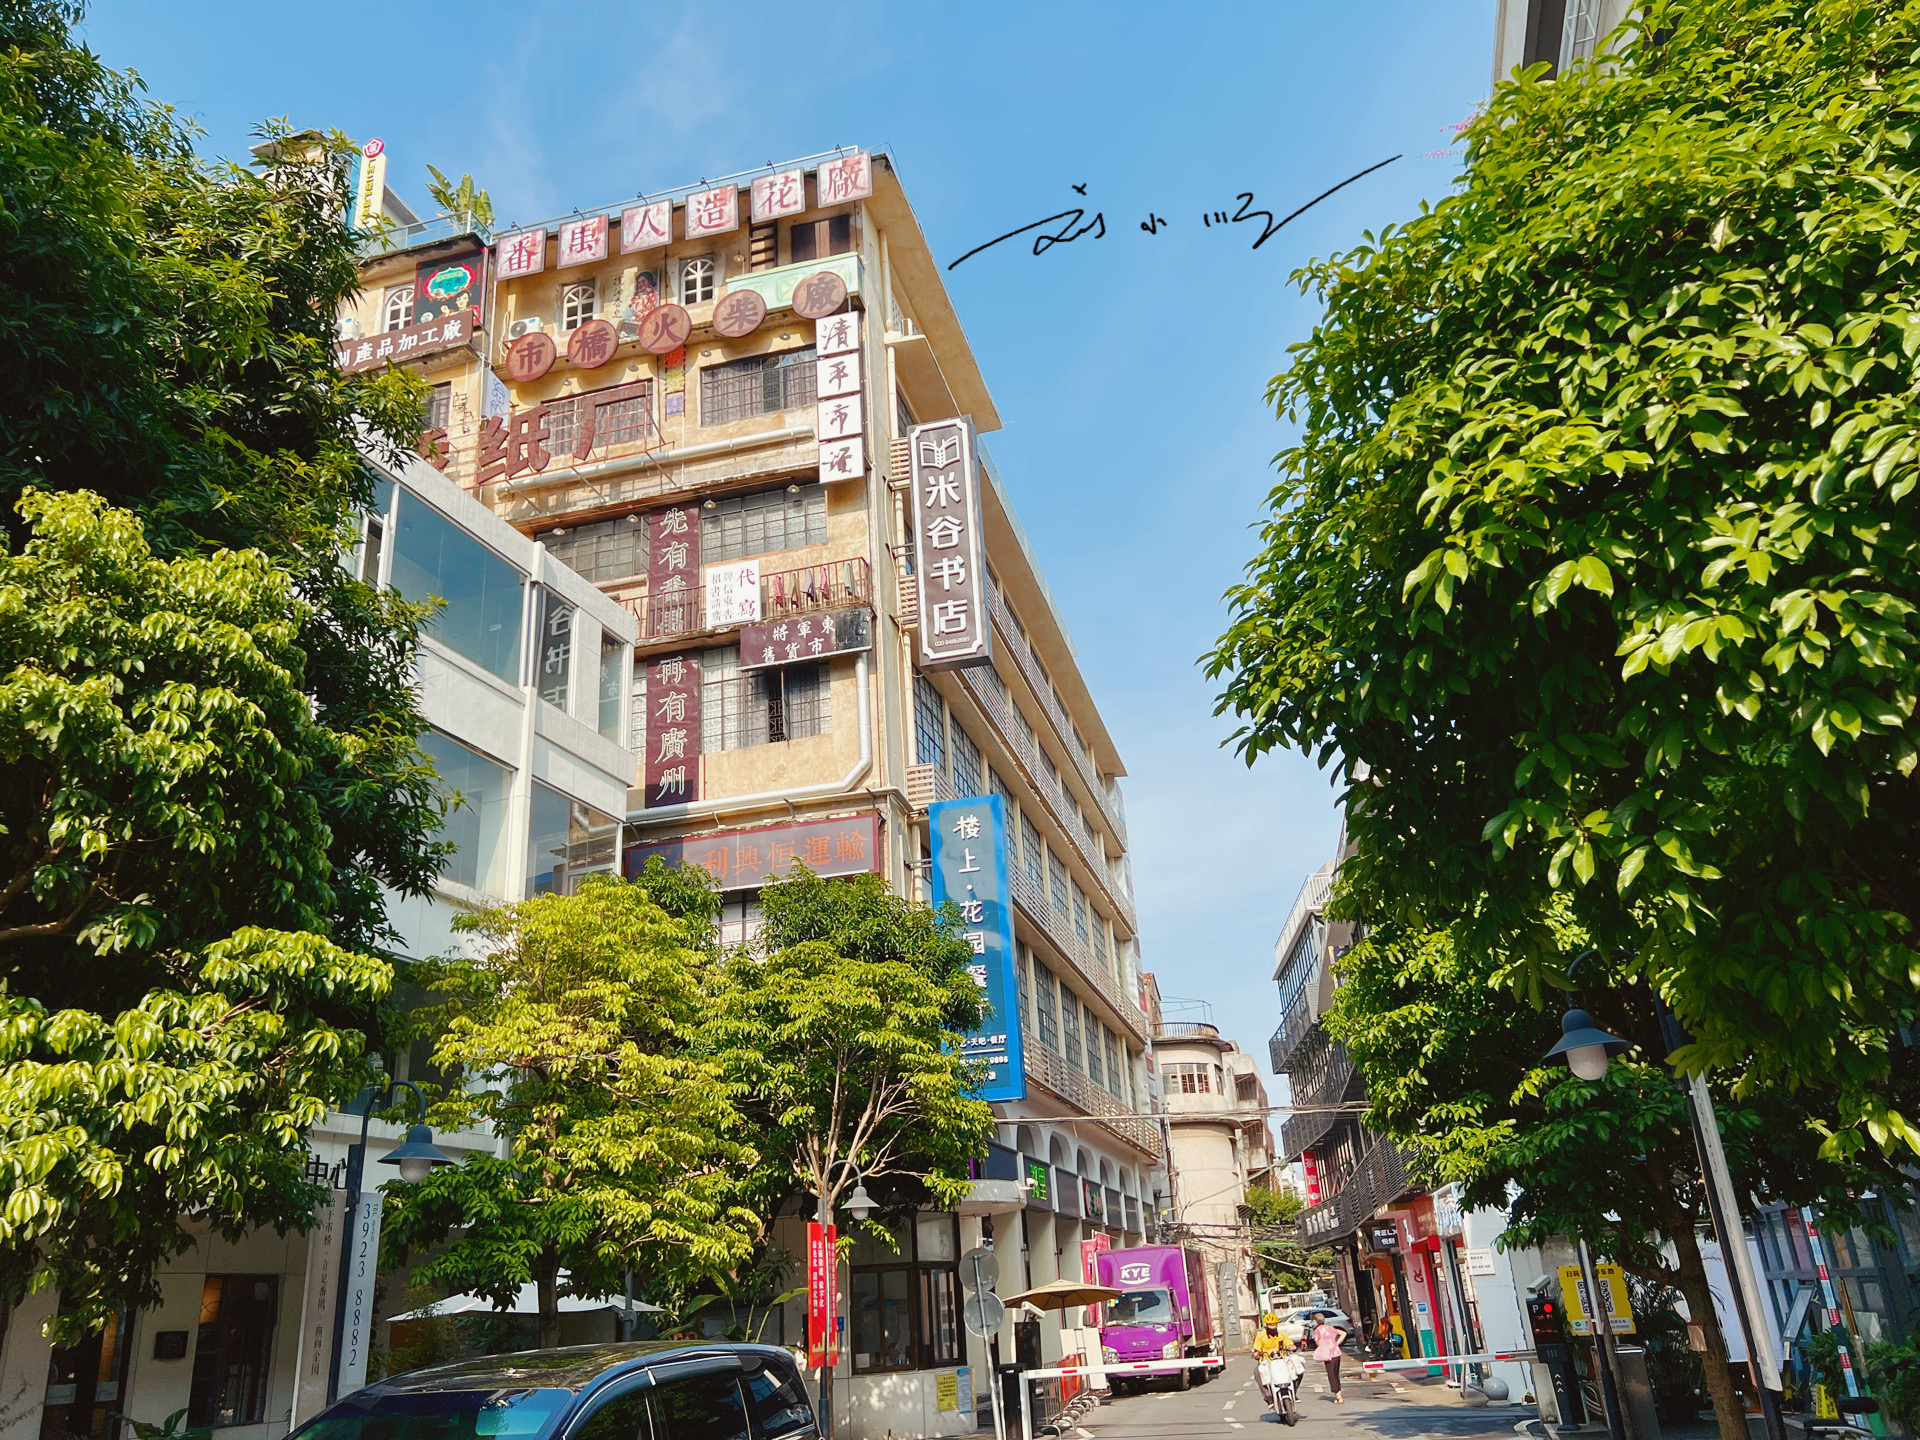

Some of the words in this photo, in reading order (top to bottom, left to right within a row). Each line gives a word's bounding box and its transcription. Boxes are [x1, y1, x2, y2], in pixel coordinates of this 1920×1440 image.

[504, 159, 863, 272] 番禺人造花廠
[516, 276, 837, 373] 市橋火柴廠
[925, 472, 967, 634] 米谷书店
[654, 656, 687, 800] 再有廣州
[1121, 1267, 1150, 1279] KYE
[1532, 1305, 1539, 1313] P
